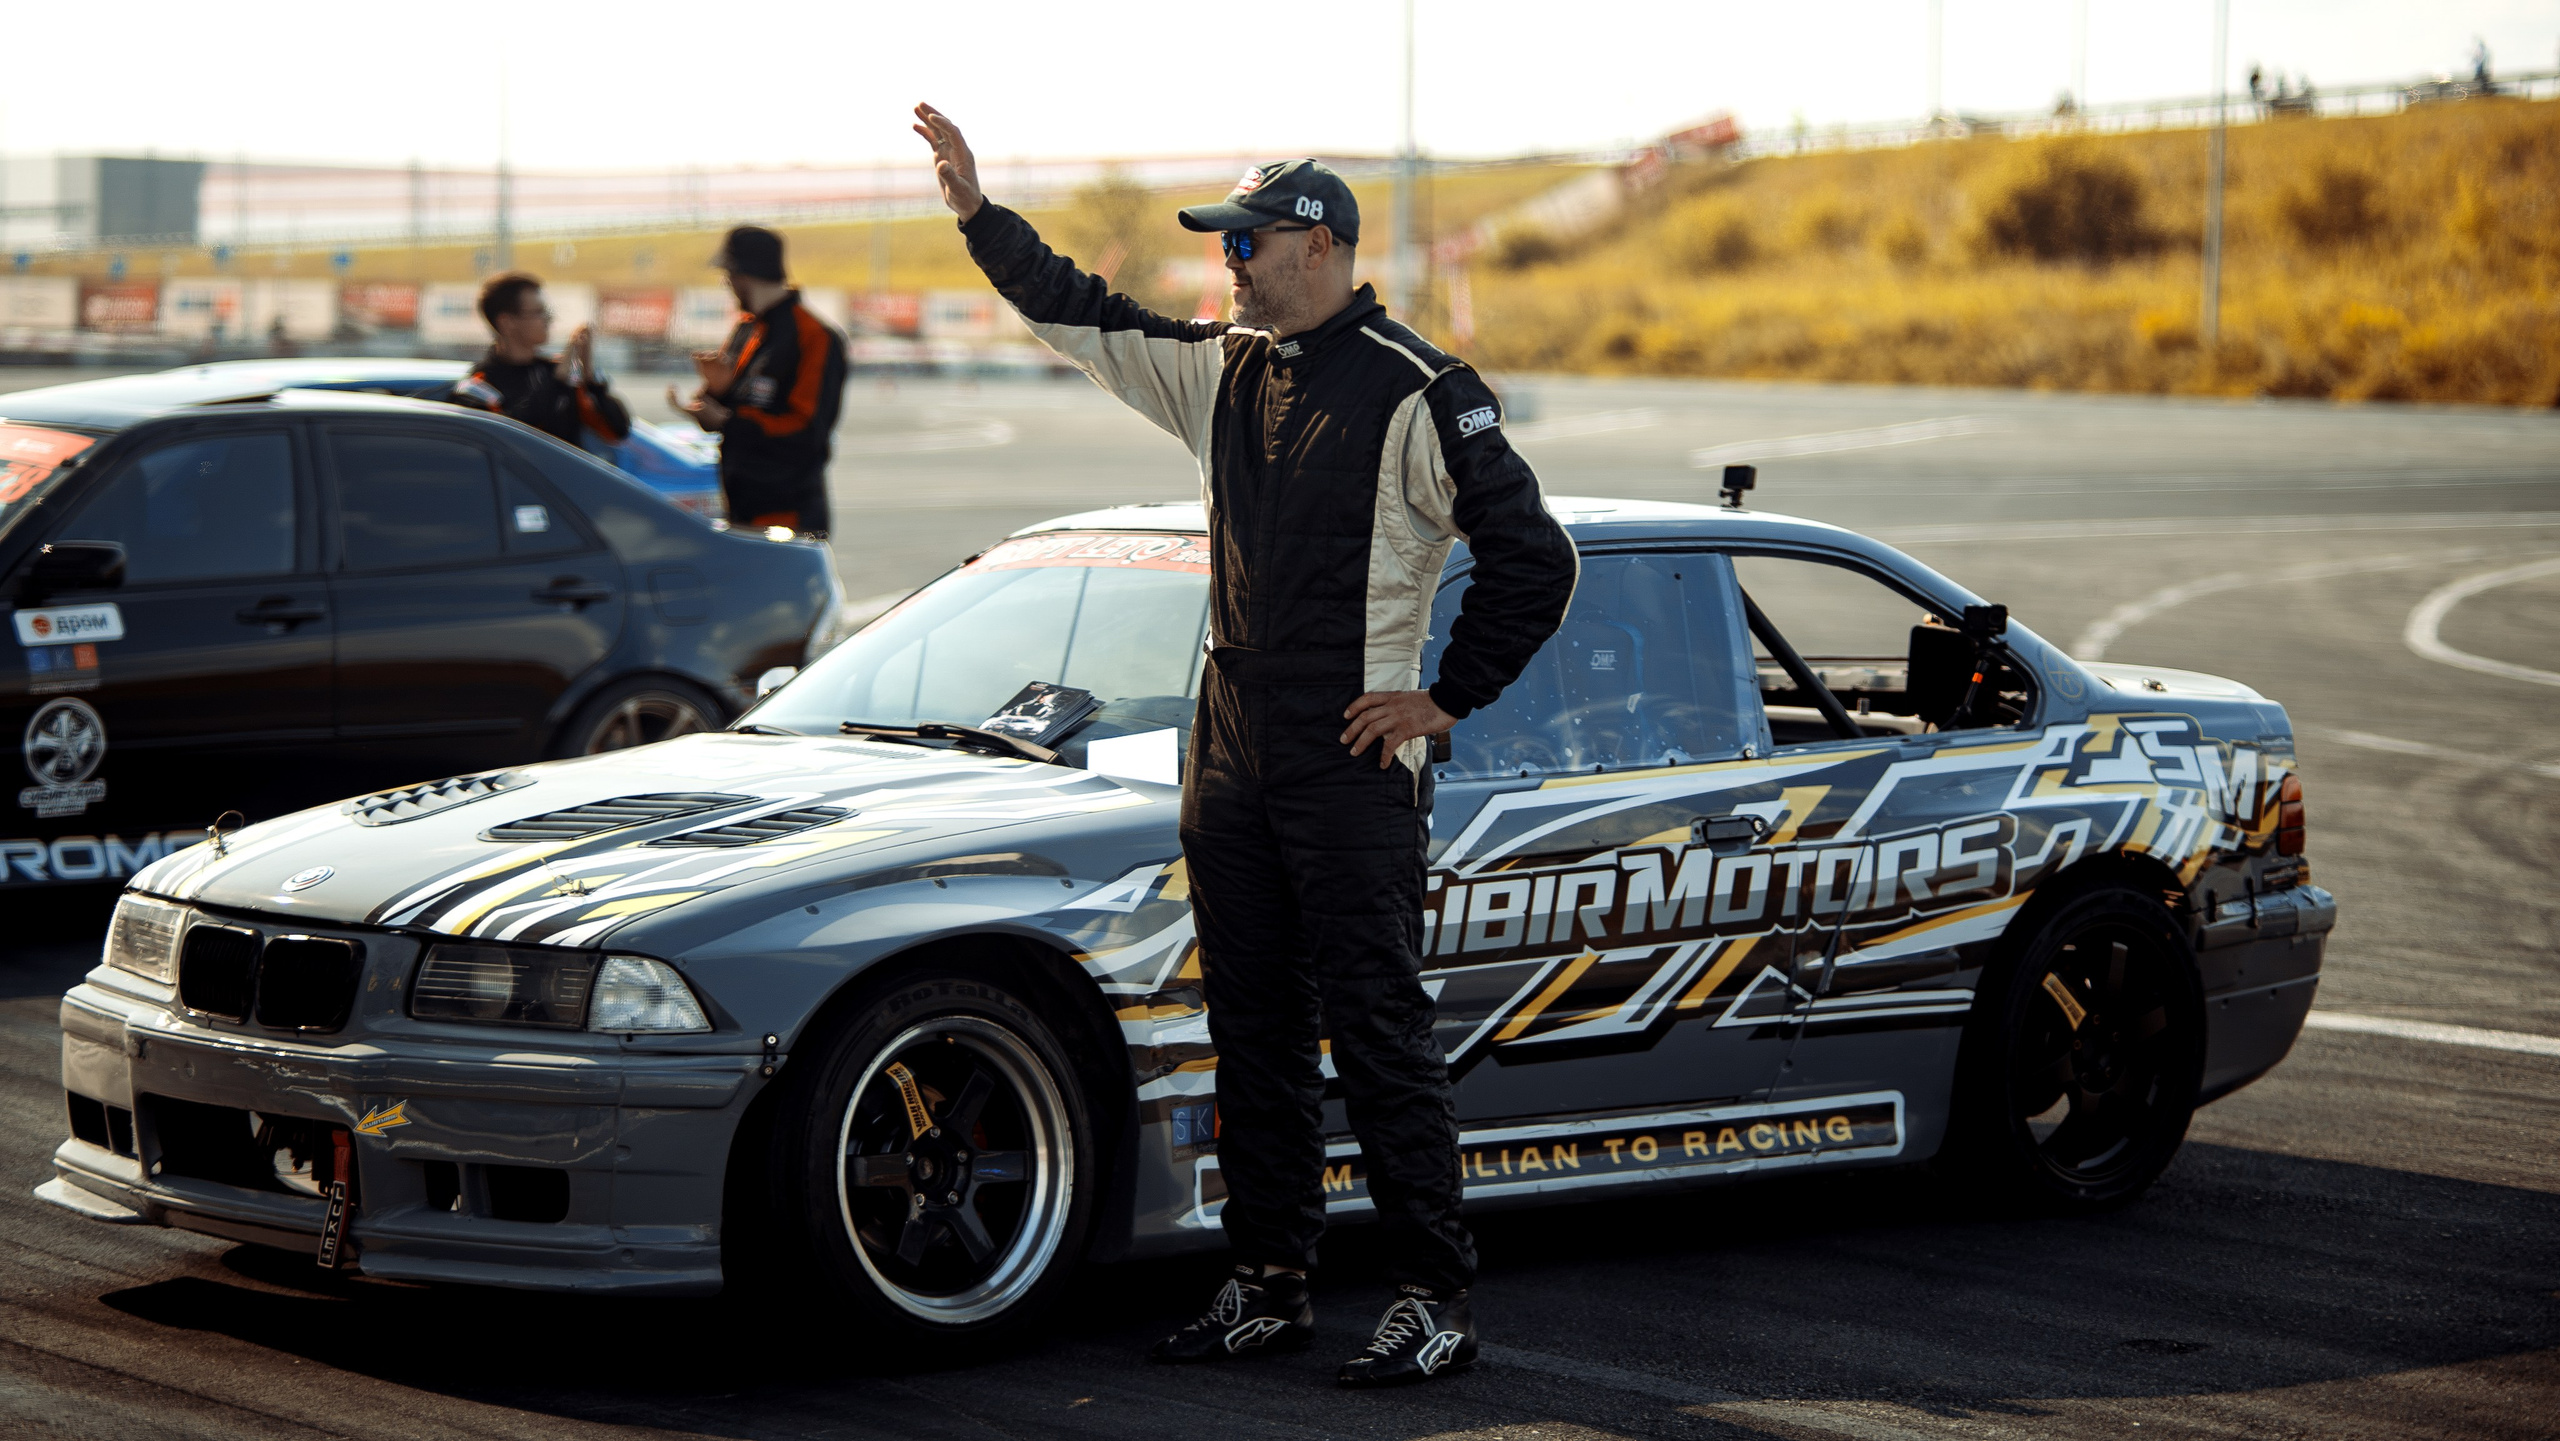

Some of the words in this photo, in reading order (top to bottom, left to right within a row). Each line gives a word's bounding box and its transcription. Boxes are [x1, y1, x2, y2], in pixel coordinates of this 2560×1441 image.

[1295, 196, 1324, 221] 08
[1278, 343, 1300, 356] OMP
[1458, 409, 1497, 434] OMP
[1590, 652, 1617, 667] OMP
[1621, 819, 2001, 936] MOTORS
[1176, 1106, 1221, 1141] SK
[1604, 1135, 1659, 1164] TO
[1684, 1115, 1855, 1159] RACING
[324, 1186, 345, 1250] LUKE
